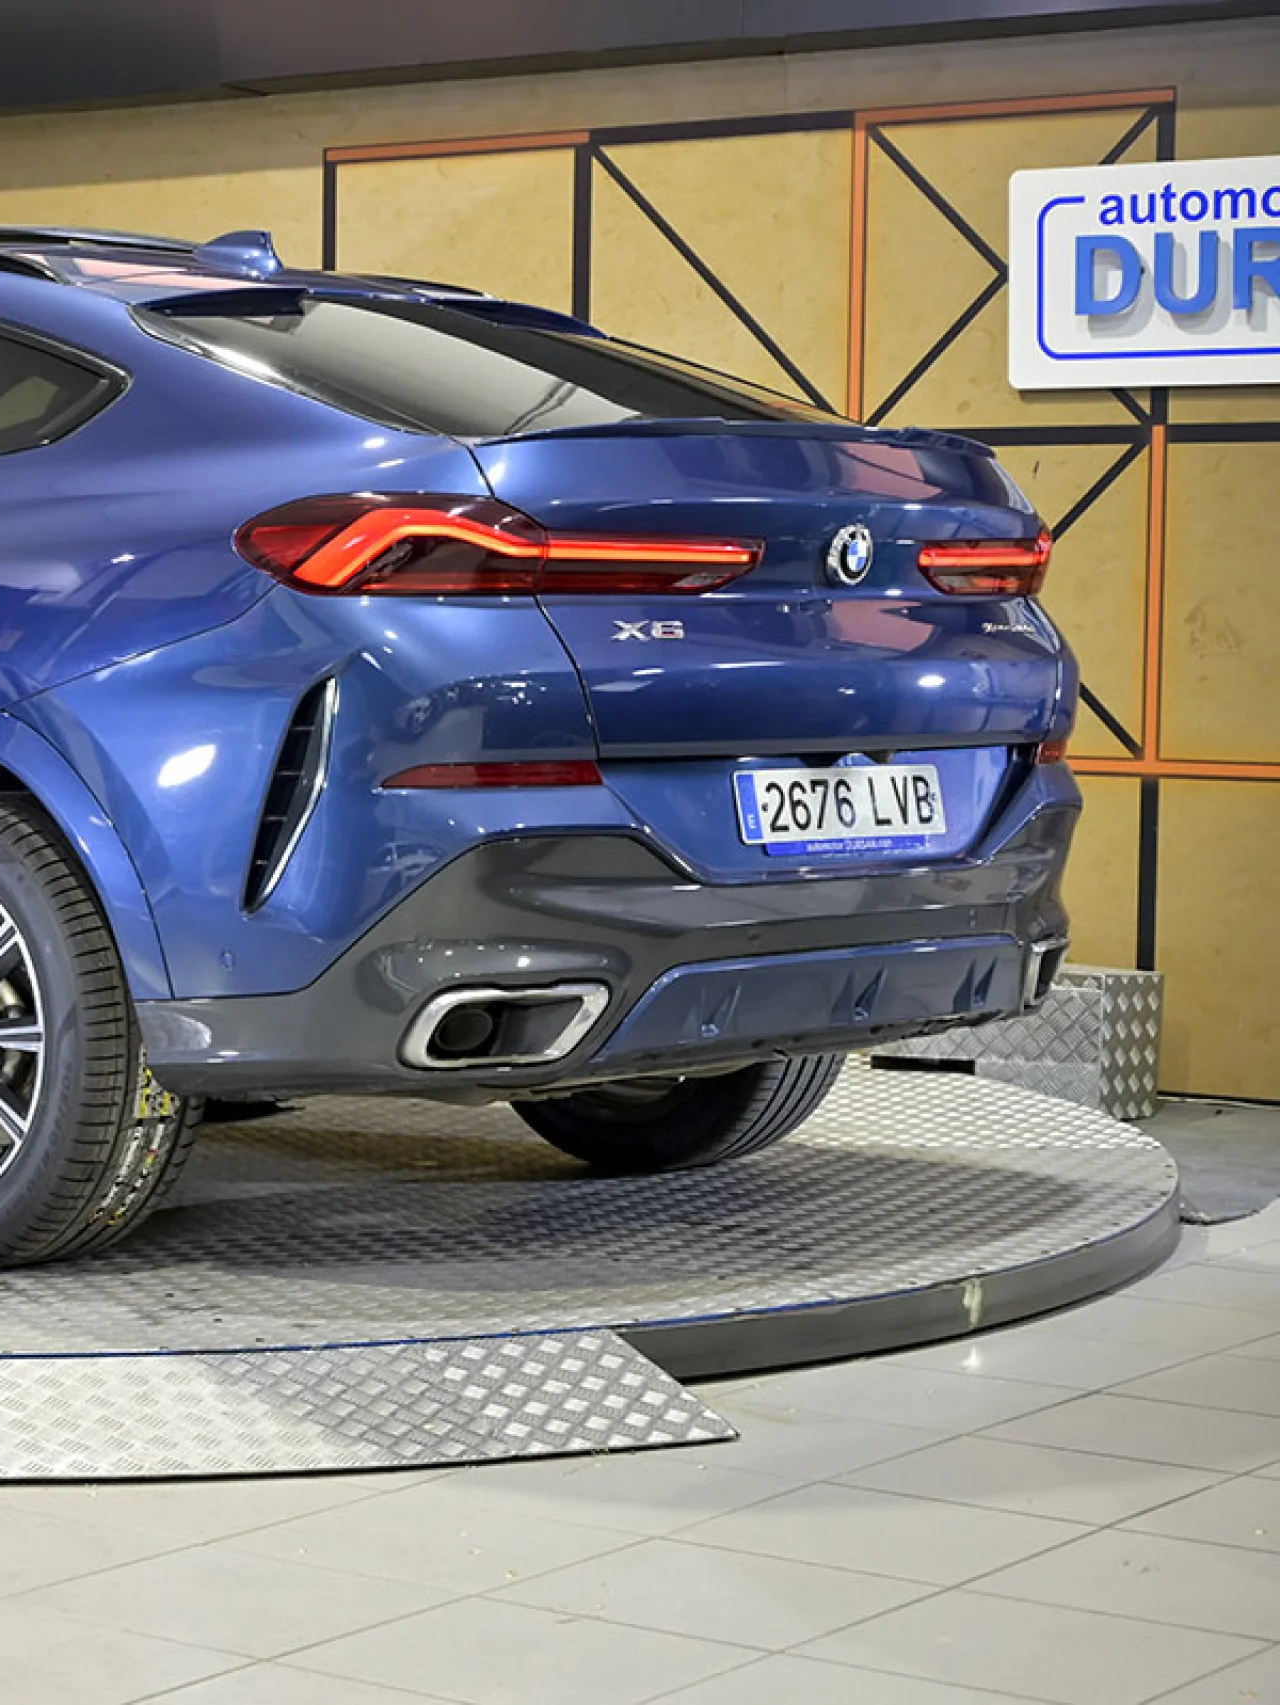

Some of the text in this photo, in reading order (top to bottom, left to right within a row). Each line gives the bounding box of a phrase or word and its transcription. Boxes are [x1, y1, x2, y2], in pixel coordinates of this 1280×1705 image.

[1098, 182, 1280, 225] automo
[1075, 227, 1280, 316] DUR
[610, 620, 684, 641] X6
[765, 778, 856, 833] 2676
[868, 774, 934, 826] LVB
